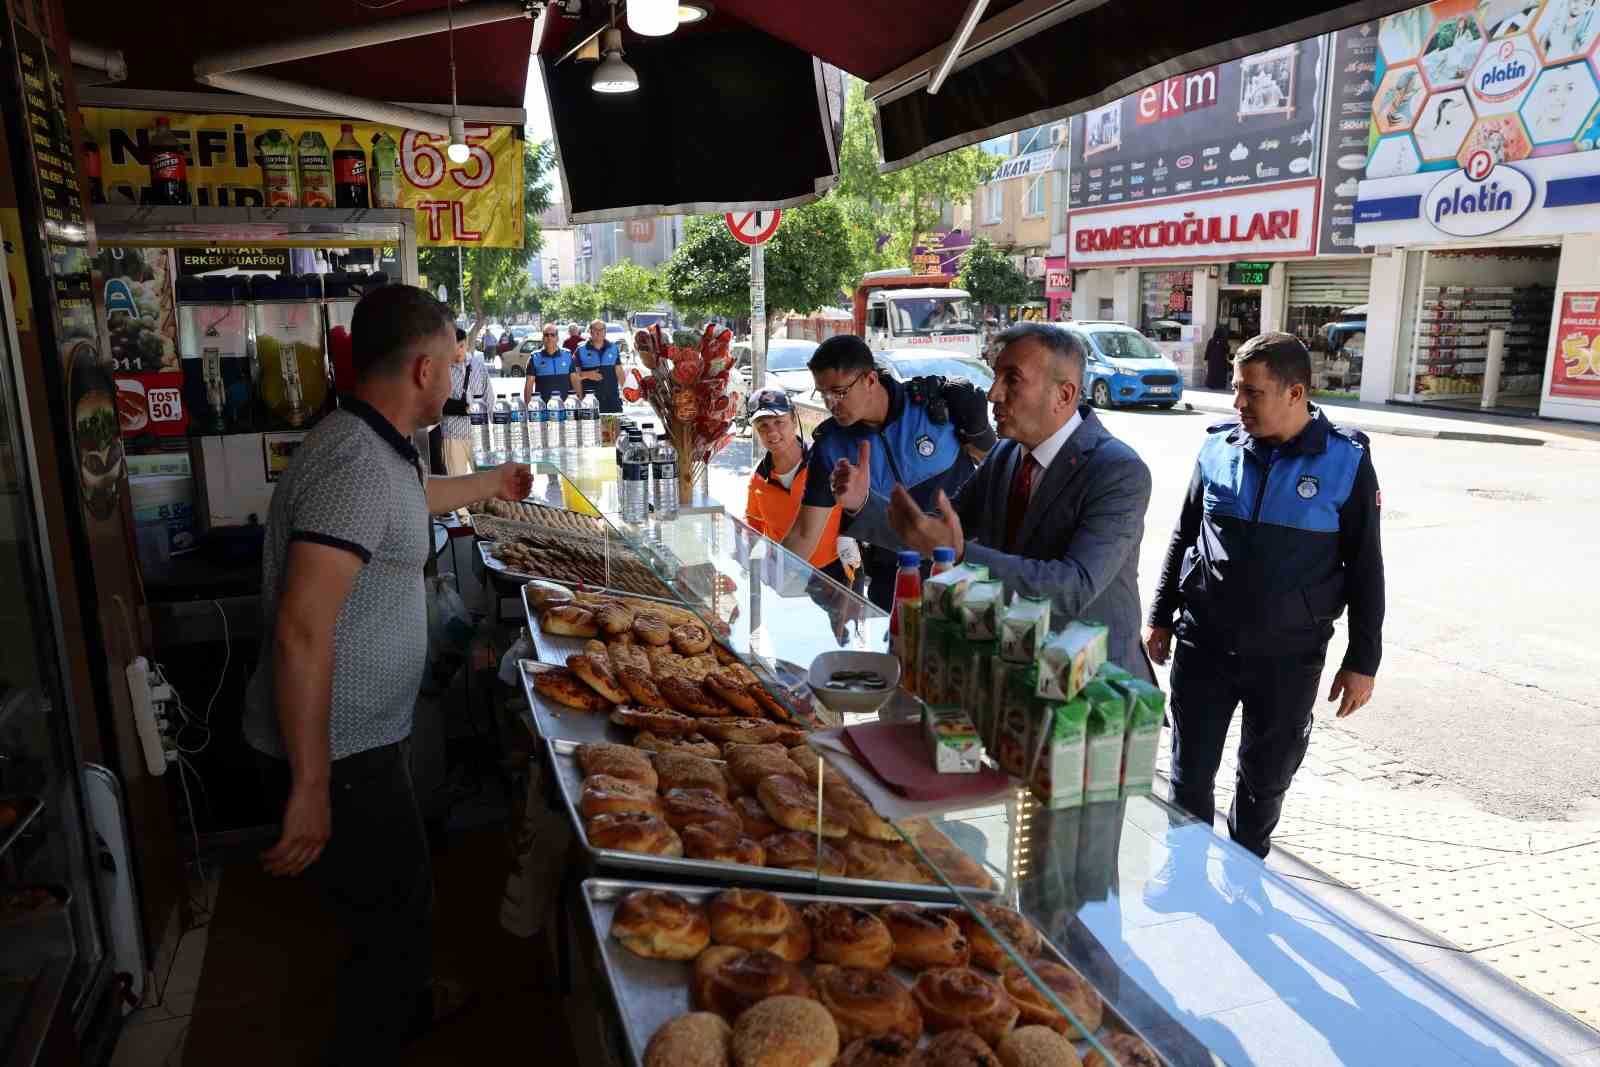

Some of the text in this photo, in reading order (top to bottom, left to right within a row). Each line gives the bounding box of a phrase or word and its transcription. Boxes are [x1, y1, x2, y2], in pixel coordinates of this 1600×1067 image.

[1139, 69, 1217, 118] ekm
[1481, 60, 1527, 91] platin
[109, 123, 280, 168] NEFİ
[400, 124, 495, 190] 65
[418, 200, 482, 241] TL
[1435, 182, 1513, 223] platin
[184, 255, 224, 266] ERKEK
[149, 391, 178, 402] TOST
[153, 403, 172, 418] 50
